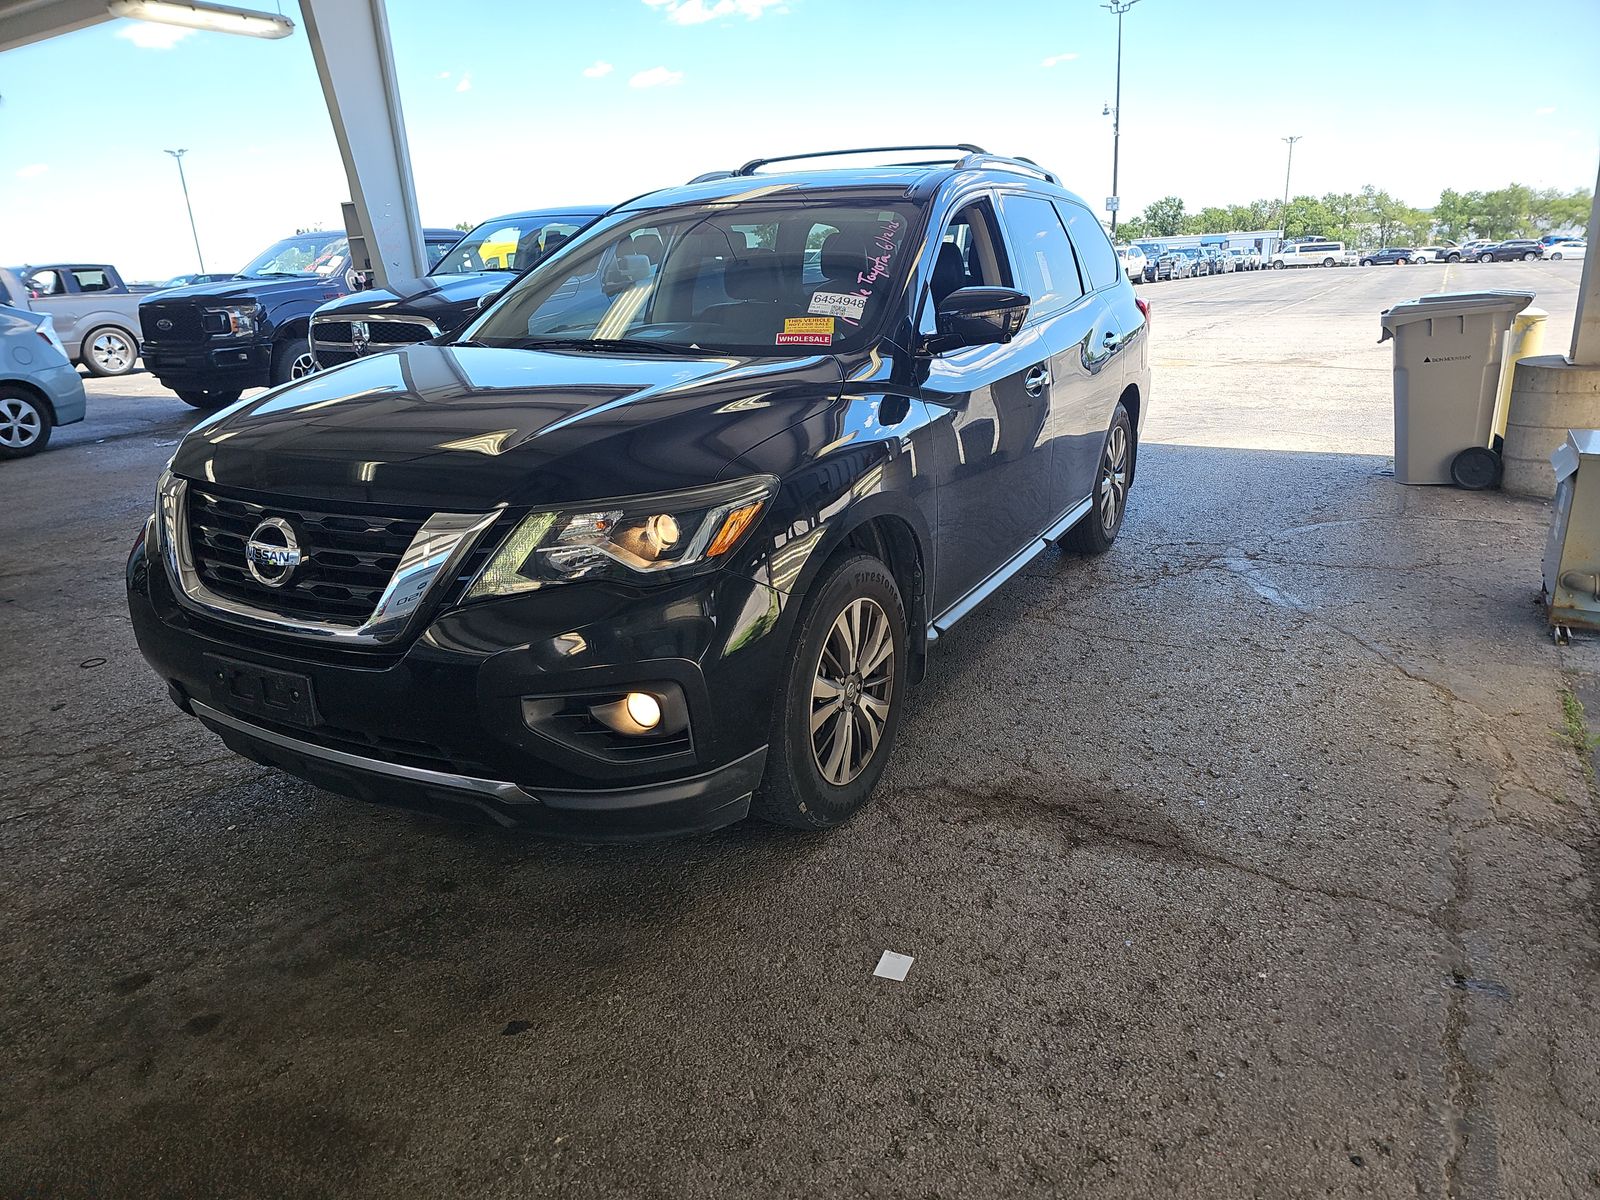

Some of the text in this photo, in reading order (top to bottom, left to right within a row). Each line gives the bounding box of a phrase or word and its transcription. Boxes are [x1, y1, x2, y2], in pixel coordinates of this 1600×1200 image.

[857, 254, 891, 284] Toyota
[814, 294, 865, 309] 6454948
[246, 545, 290, 562] NISSAN
